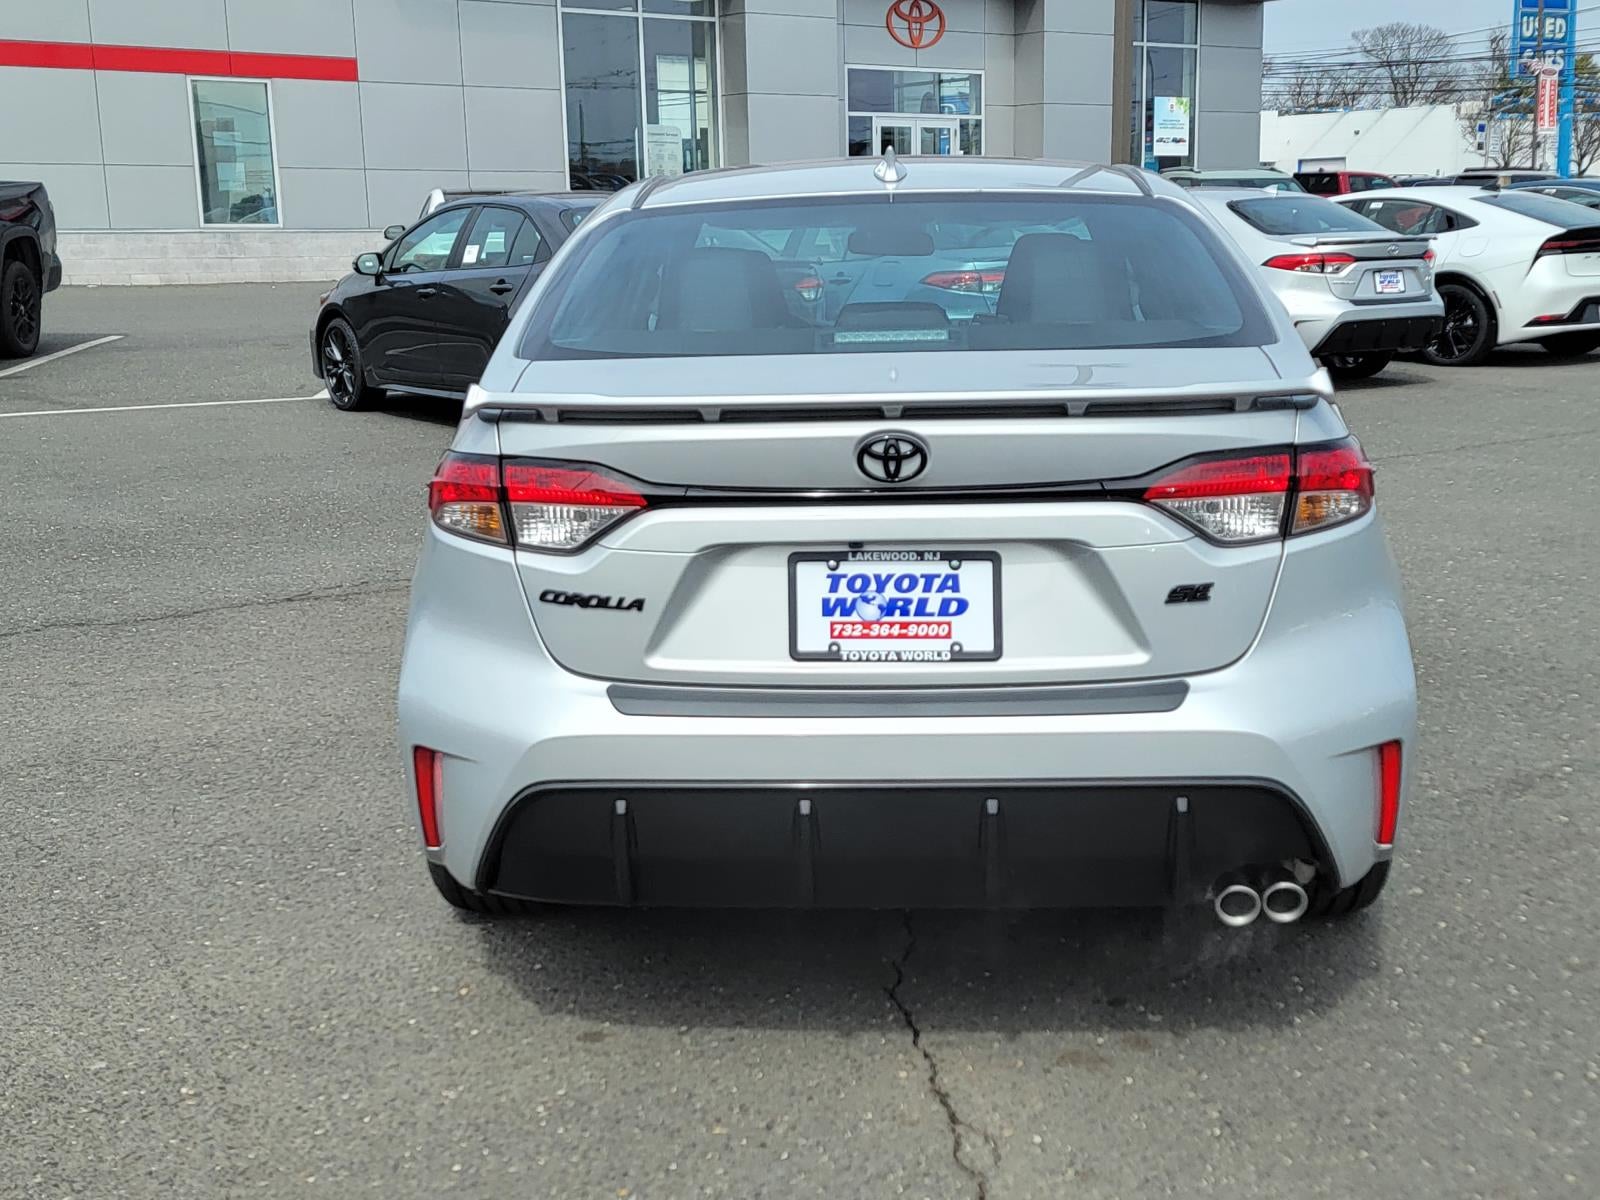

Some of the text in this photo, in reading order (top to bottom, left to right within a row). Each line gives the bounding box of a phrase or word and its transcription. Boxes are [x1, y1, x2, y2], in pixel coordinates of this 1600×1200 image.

[924, 551, 941, 561] NJ
[826, 573, 961, 594] TOYOTA
[539, 589, 646, 612] COROLLA
[1164, 582, 1215, 604] SE
[832, 623, 950, 637] 732-364-9000
[840, 650, 951, 662] TOYOTA WORLD
